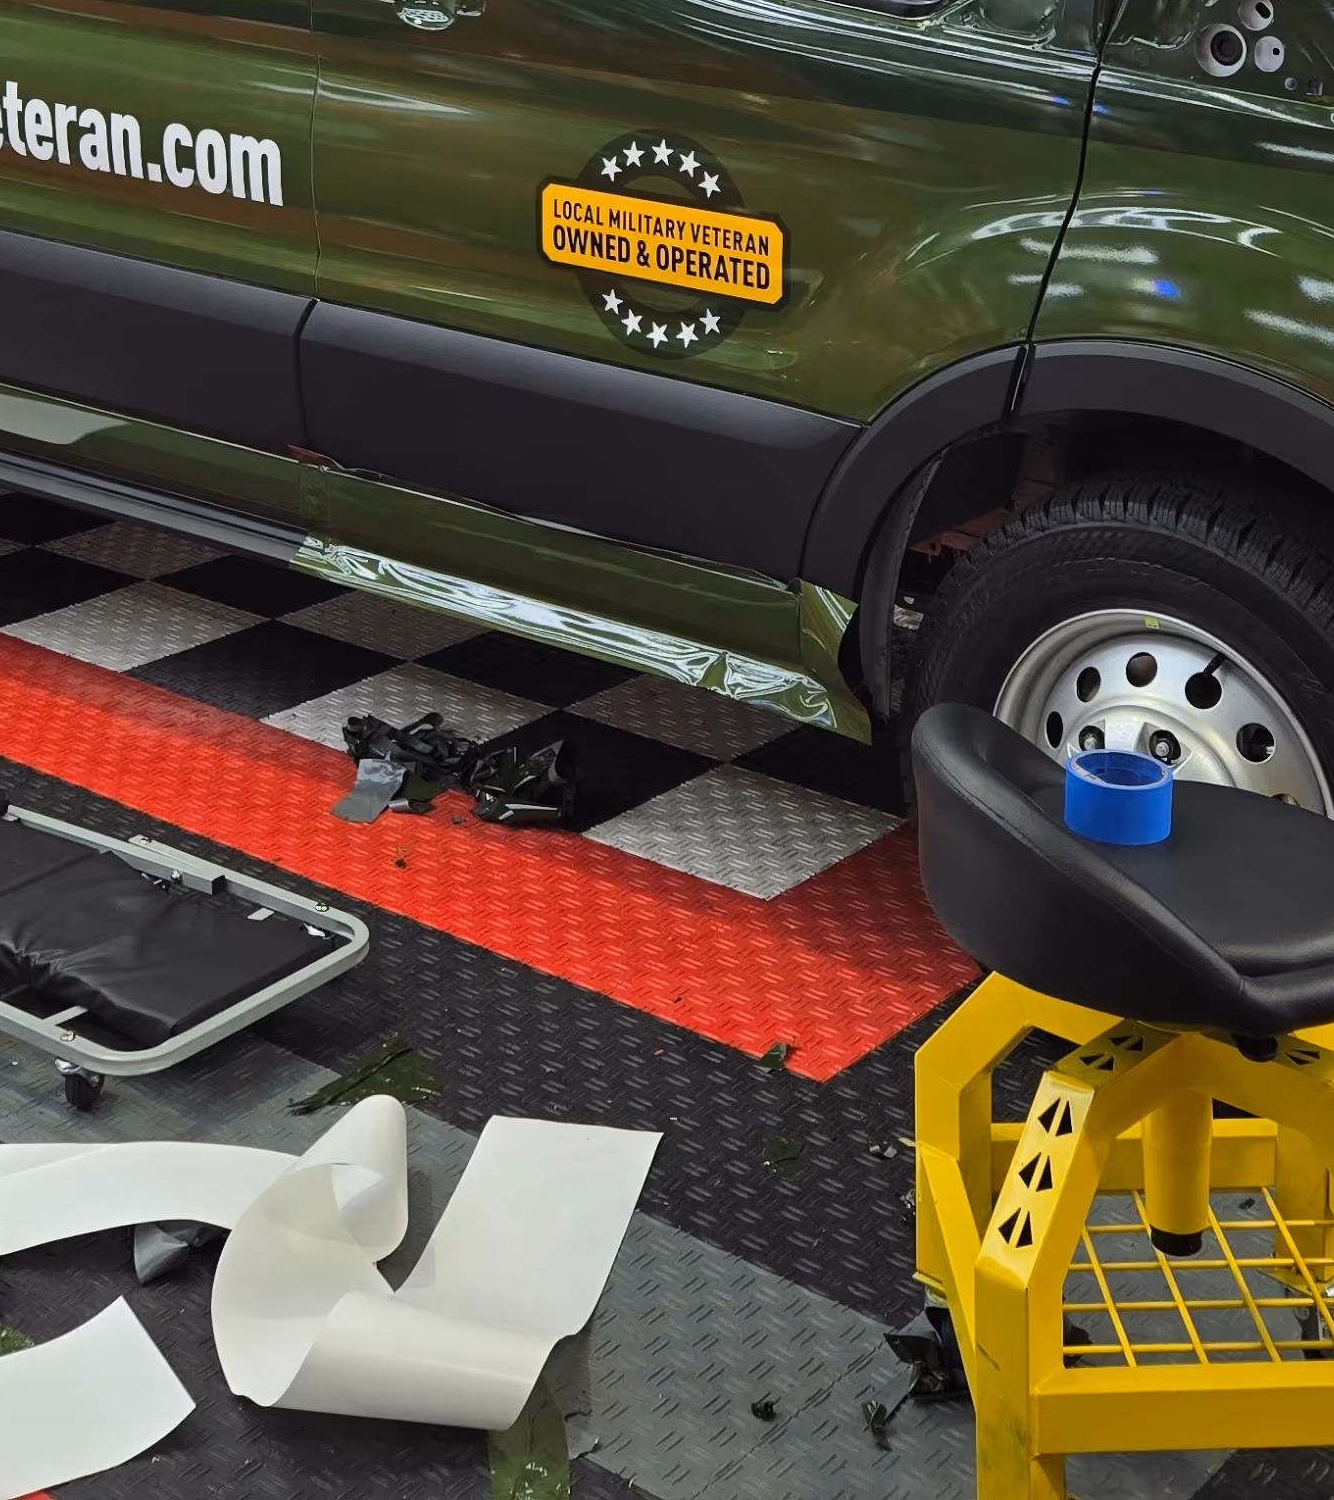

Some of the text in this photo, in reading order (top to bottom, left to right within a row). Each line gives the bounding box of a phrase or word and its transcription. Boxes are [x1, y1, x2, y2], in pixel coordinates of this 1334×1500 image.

[553, 198, 769, 257] LOCAL MILITARY VETERAN
[553, 225, 770, 290] OWNED & OPERATED
